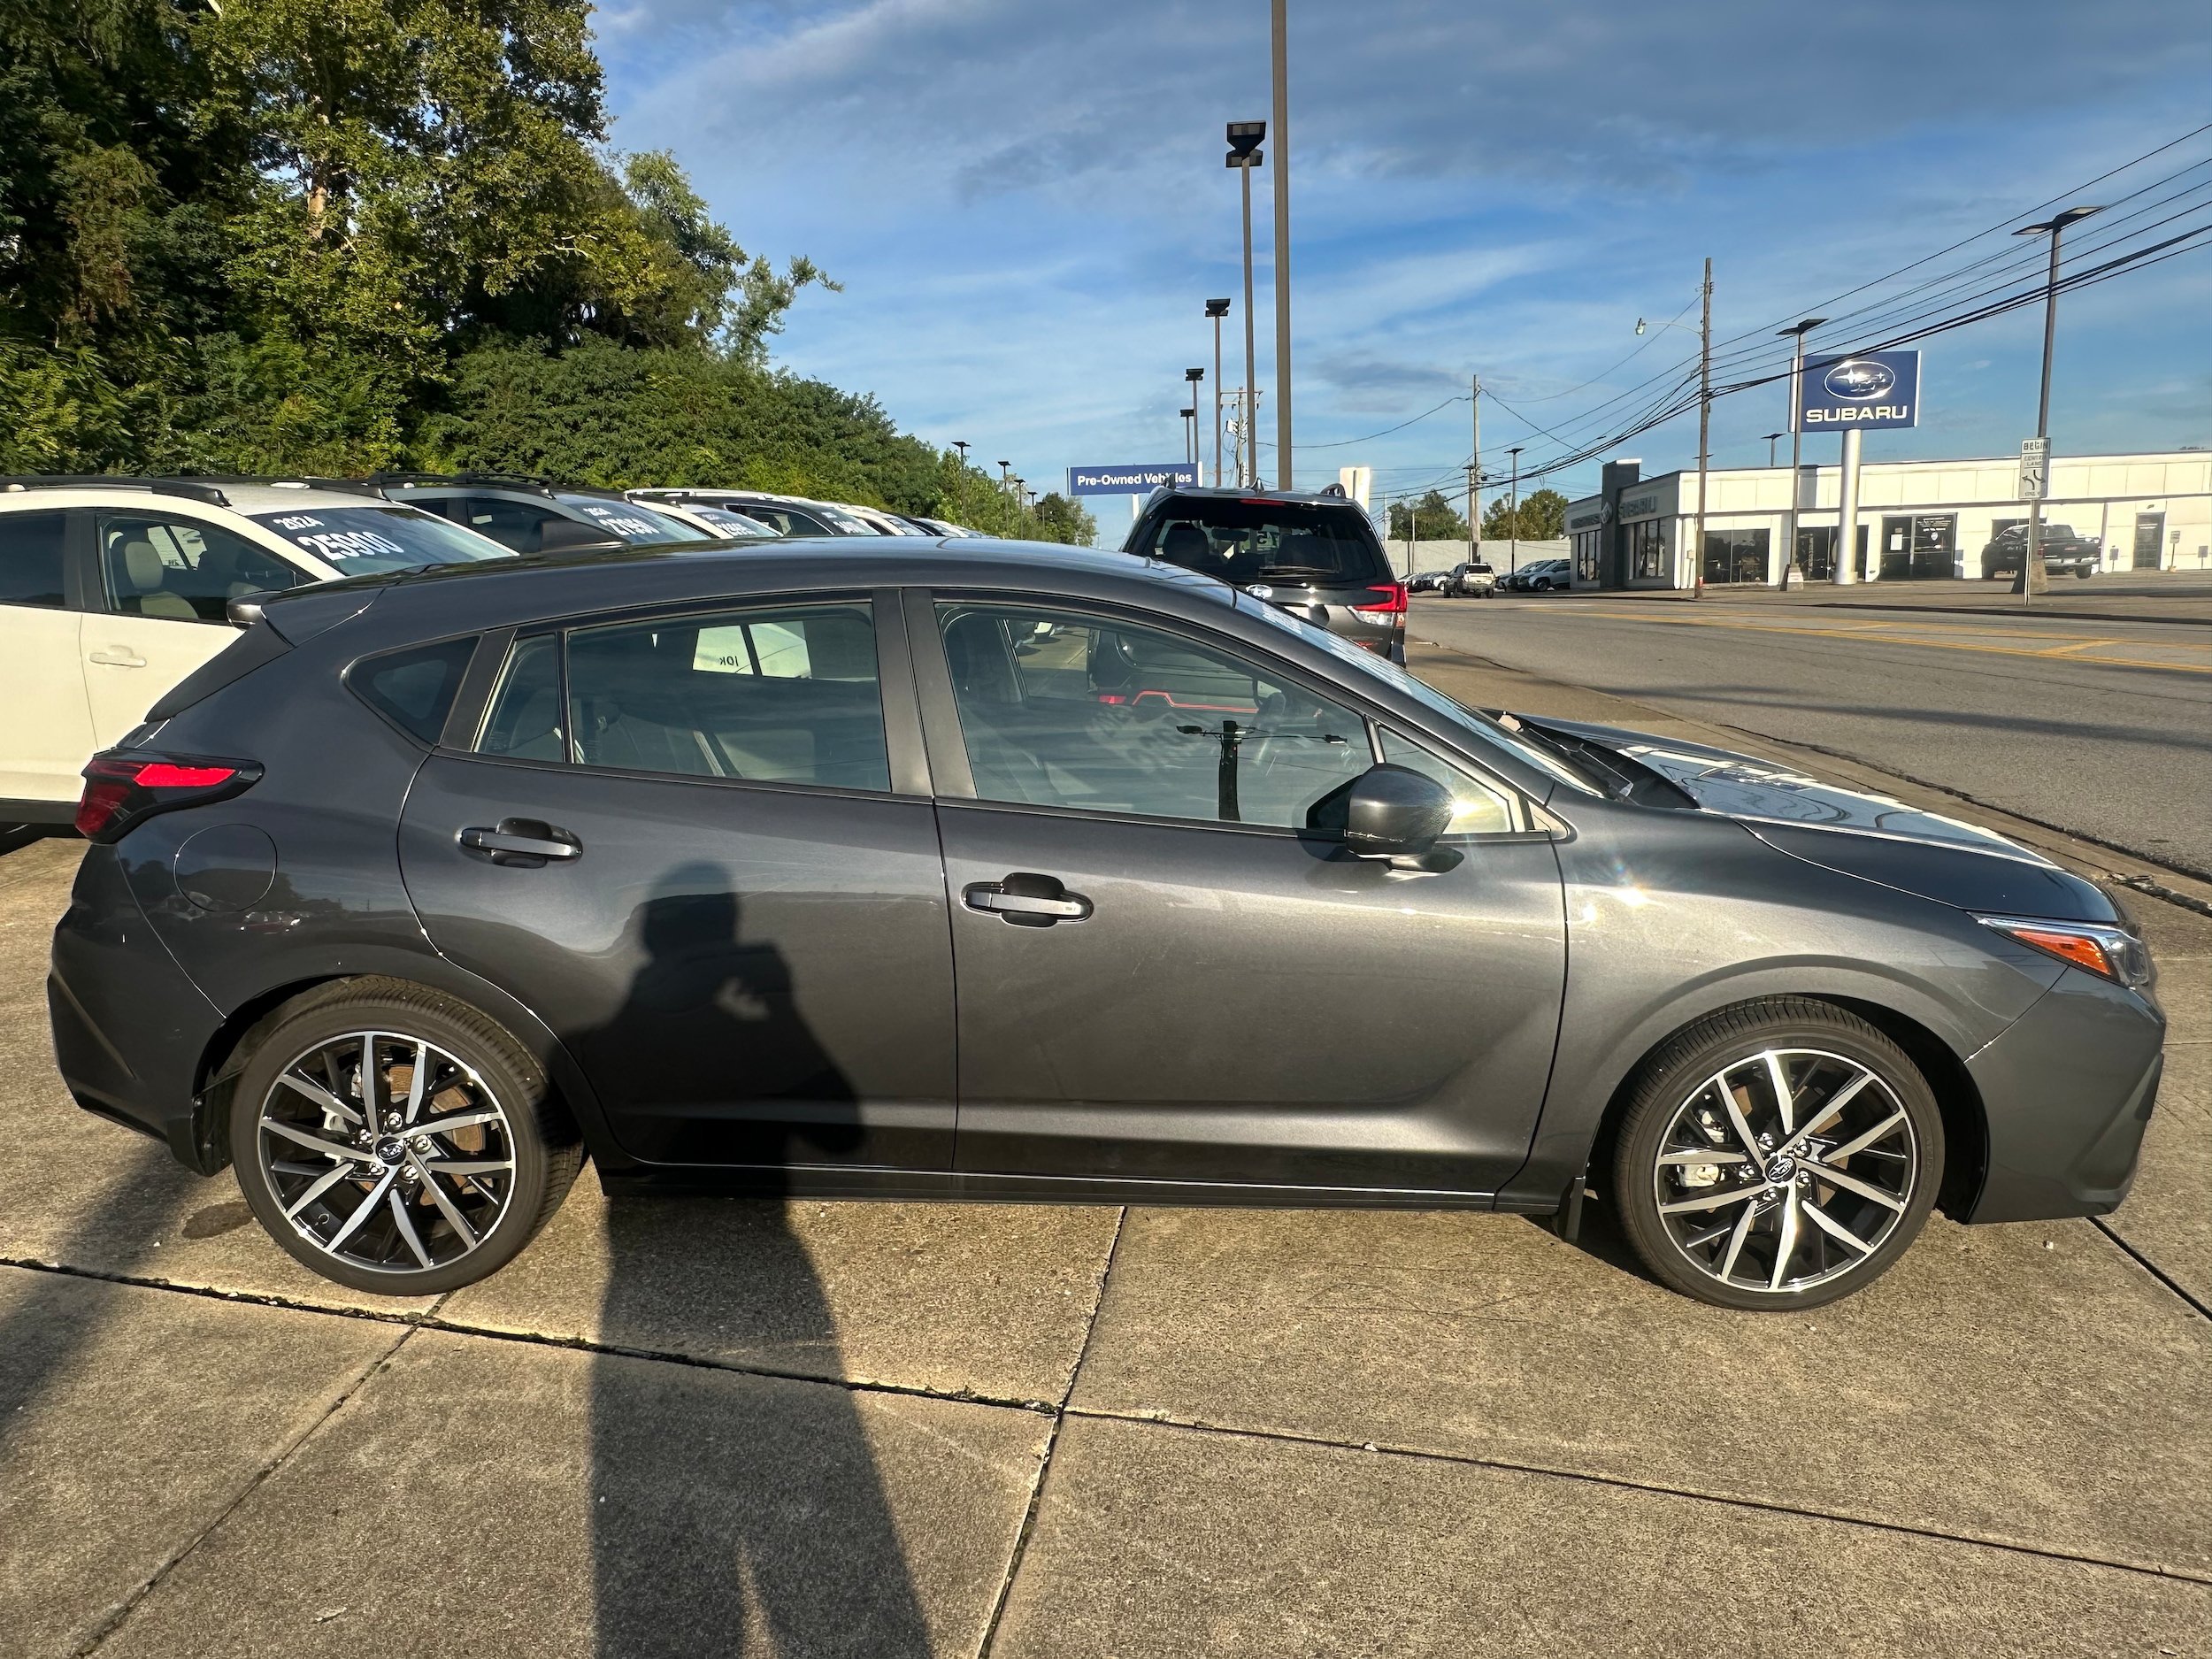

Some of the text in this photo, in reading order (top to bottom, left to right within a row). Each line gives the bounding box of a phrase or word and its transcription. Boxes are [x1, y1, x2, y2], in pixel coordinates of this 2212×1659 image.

[1806, 405, 1908, 423] SUBARU
[2024, 442, 2048, 450] BEGIN
[1077, 472, 1193, 487] Pre-Owned Vehles
[273, 515, 326, 531] 2024
[296, 531, 405, 561] 25900
